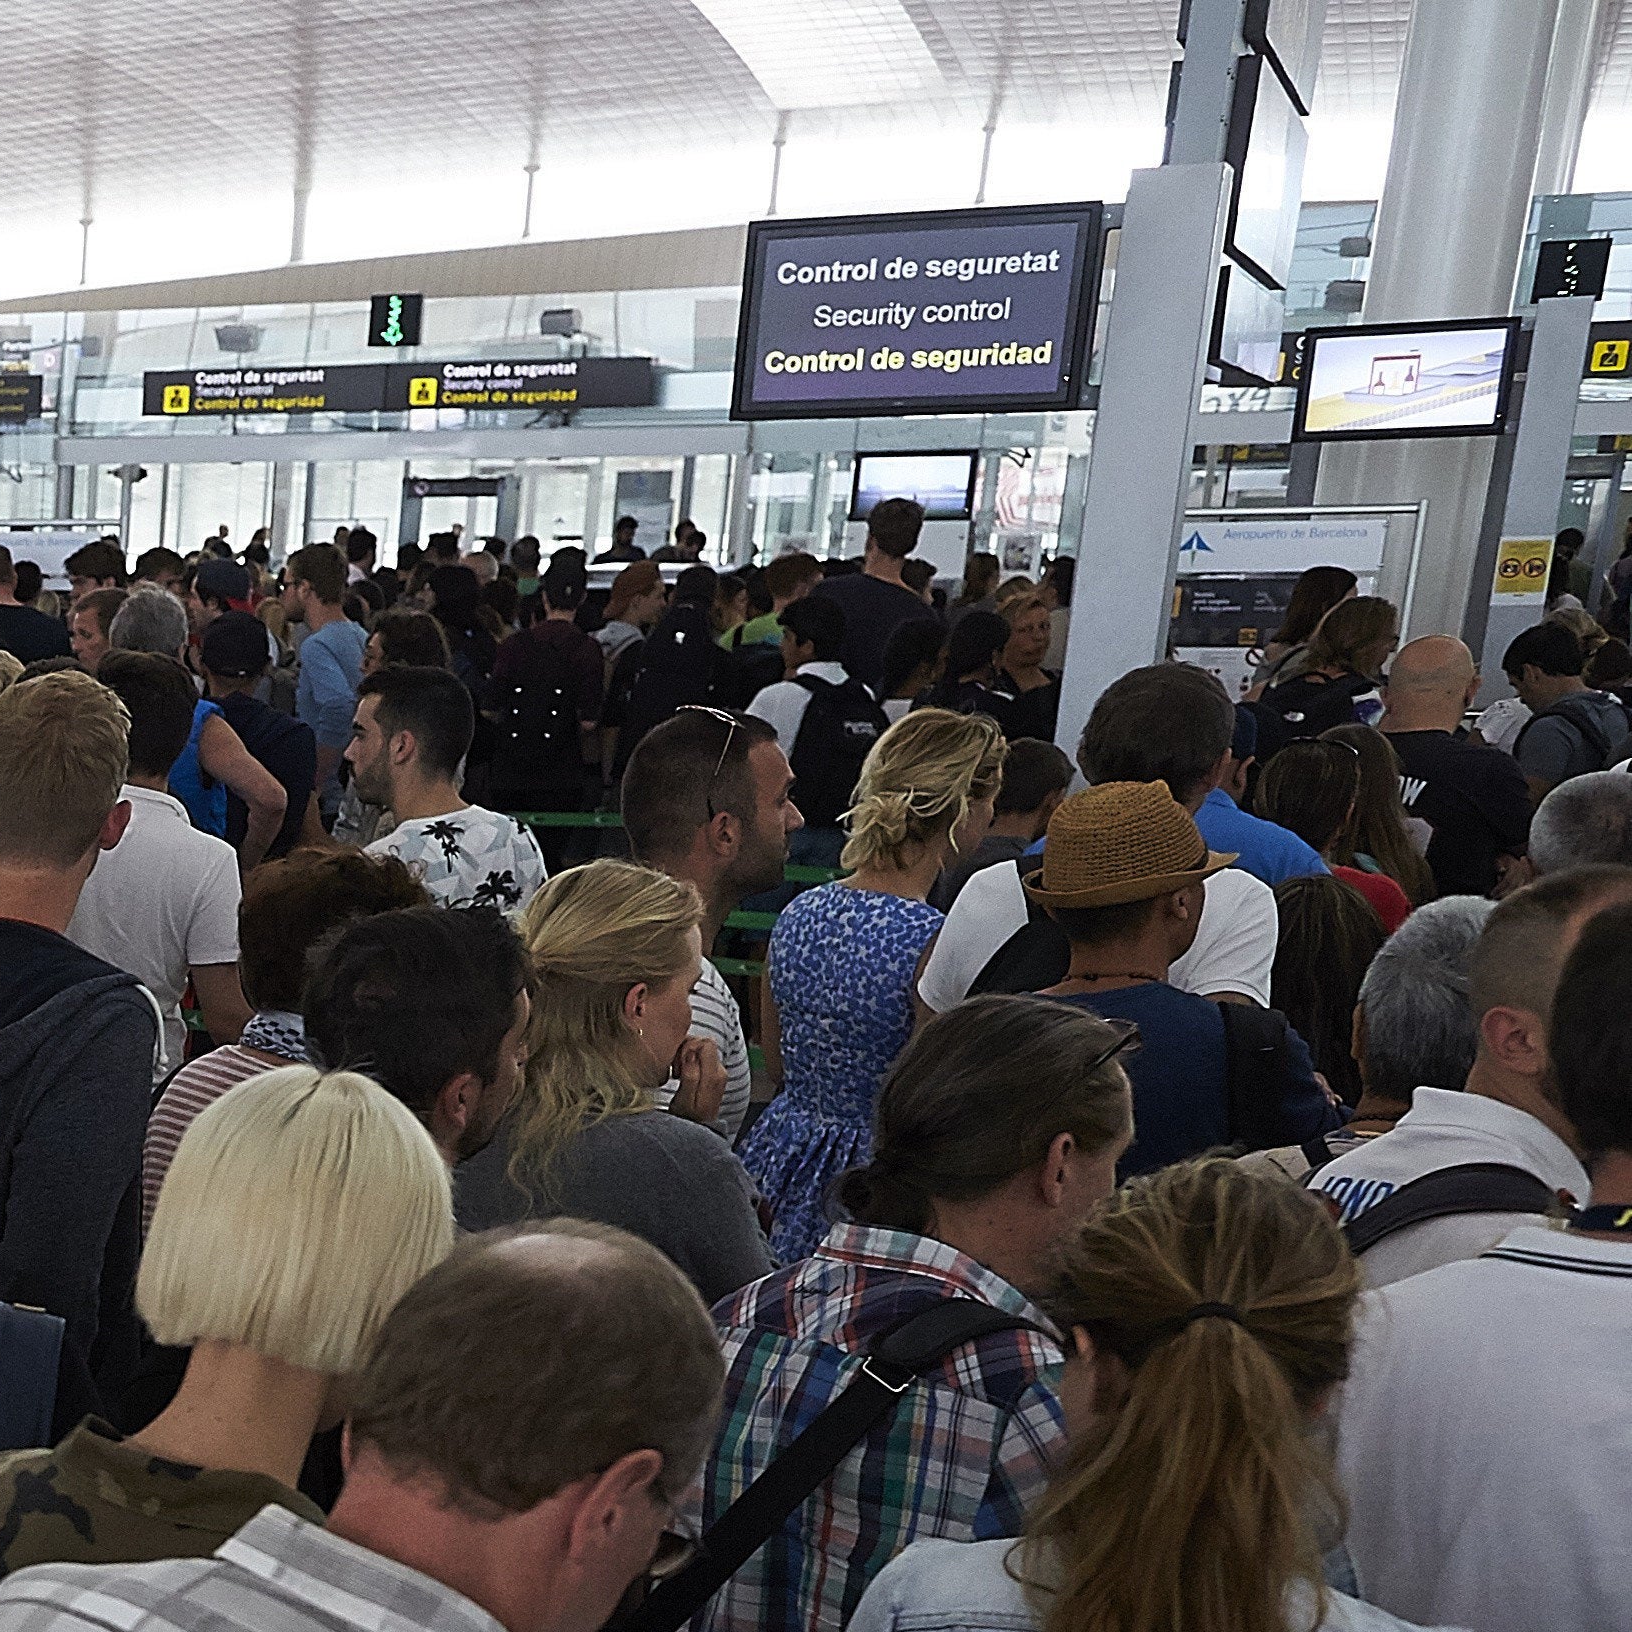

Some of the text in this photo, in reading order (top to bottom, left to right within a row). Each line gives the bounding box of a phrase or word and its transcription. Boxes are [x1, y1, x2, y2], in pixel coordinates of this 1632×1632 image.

[777, 249, 1060, 284] Control de seguretat
[813, 297, 1011, 330] Security control
[764, 341, 1053, 374] Control de seguridad
[195, 369, 325, 386] Control de seguretat
[443, 362, 577, 378] Control de seguretat
[194, 395, 325, 411] Control de seguridad
[442, 389, 577, 405] Control de seguridad
[1224, 528, 1367, 540] Aeropuerto de Barcelona
